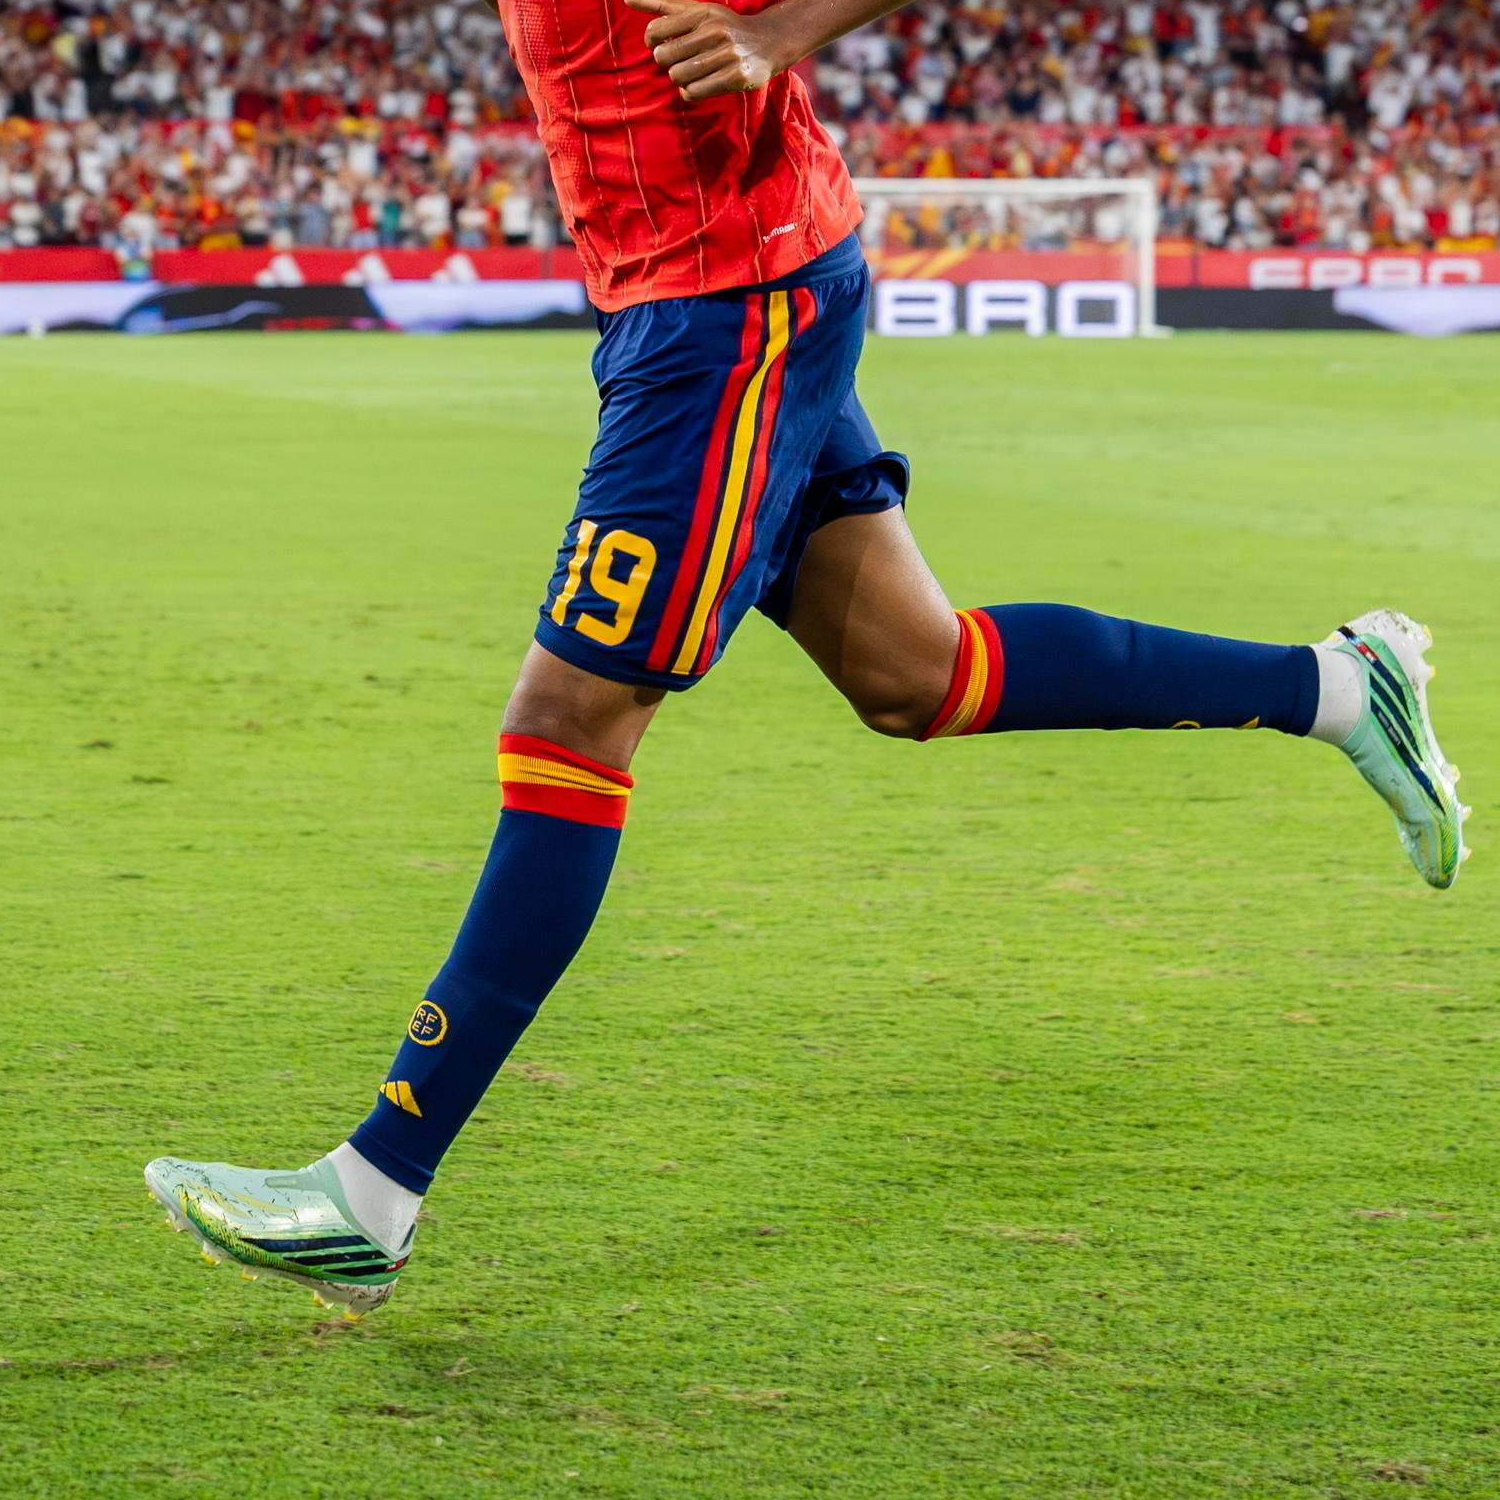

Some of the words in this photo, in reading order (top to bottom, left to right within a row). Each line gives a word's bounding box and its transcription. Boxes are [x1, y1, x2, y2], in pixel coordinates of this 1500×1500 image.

[874, 278, 1137, 338] BRO
[551, 518, 658, 647] 19
[411, 1020, 434, 1035] EF
[417, 1006, 438, 1024] RF
